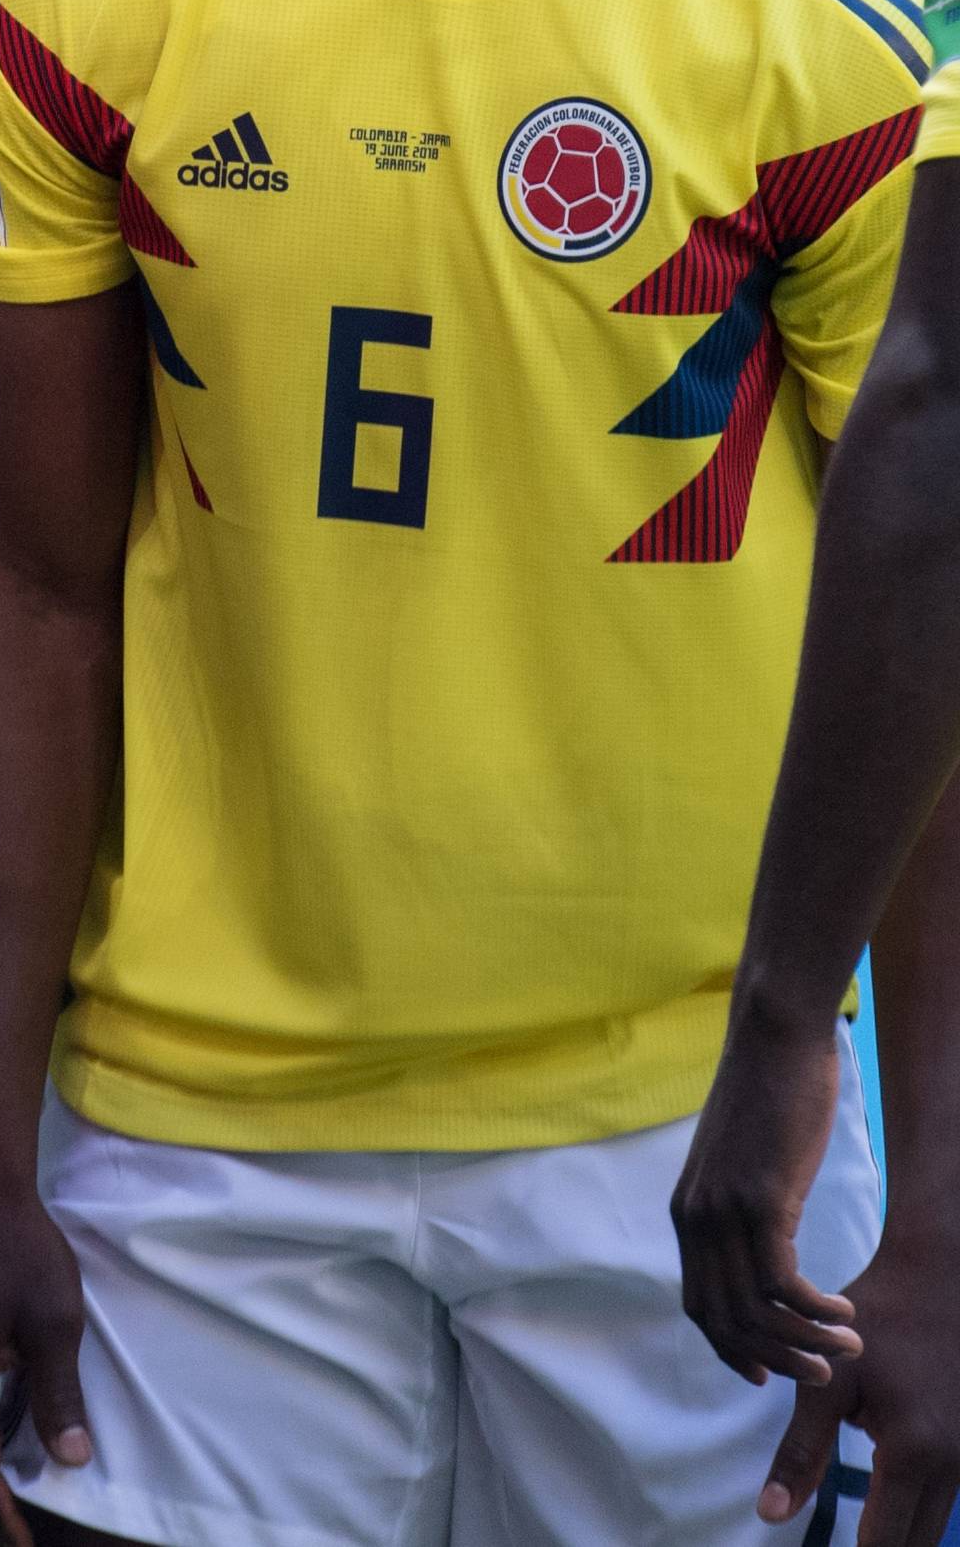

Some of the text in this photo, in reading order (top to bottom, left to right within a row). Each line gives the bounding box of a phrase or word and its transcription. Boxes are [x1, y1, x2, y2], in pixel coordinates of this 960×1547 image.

[349, 128, 408, 143] COLOMBIA
[419, 133, 451, 147] JAPAN
[509, 108, 641, 188] FEDERACION COLOMBIANA DE FUTBOL
[365, 143, 439, 160] 19 JUNE 2018
[177, 160, 289, 192] adidas
[375, 157, 426, 173] SARANSK
[317, 305, 435, 530] 6
